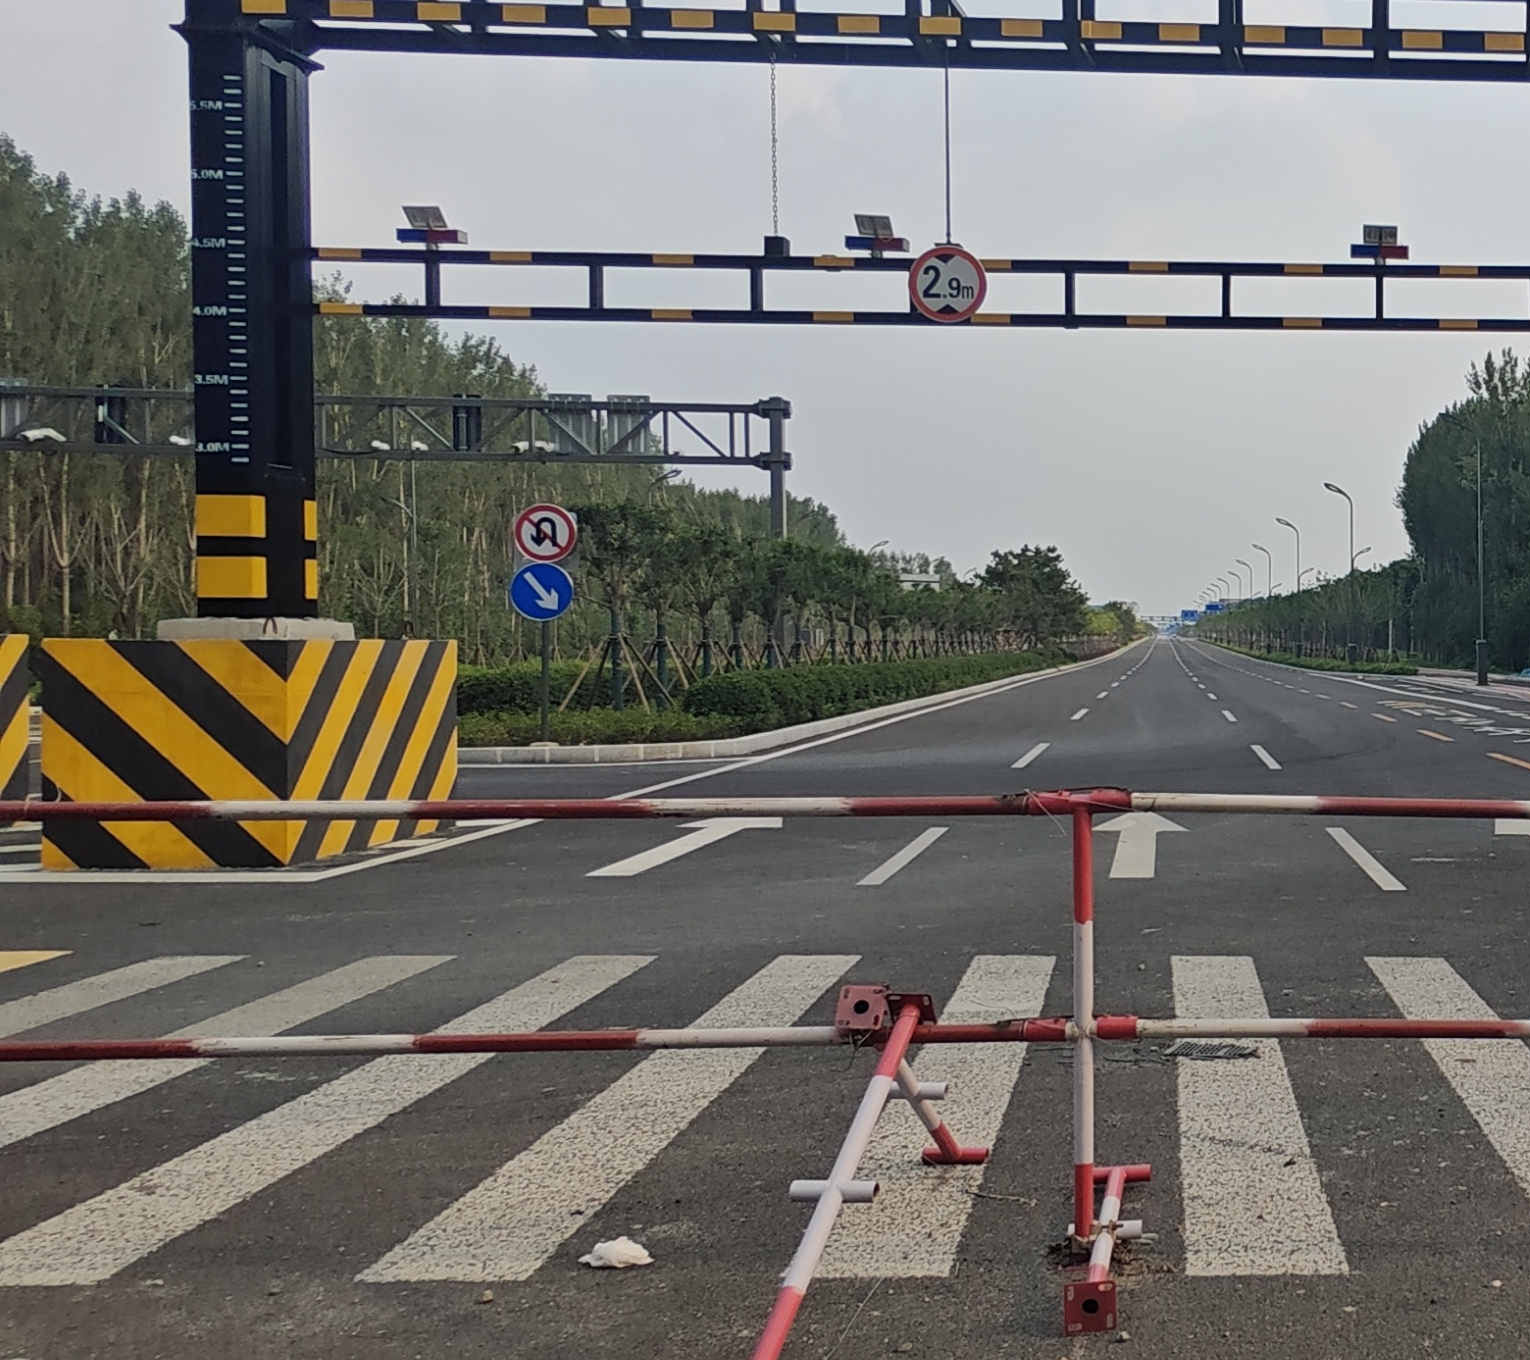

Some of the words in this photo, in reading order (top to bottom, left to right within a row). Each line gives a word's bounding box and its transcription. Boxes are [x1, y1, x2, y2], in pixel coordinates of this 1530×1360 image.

[922, 265, 974, 299] 2.9m
[192, 306, 228, 316] 4.0M
[194, 374, 229, 385] 3.5M
